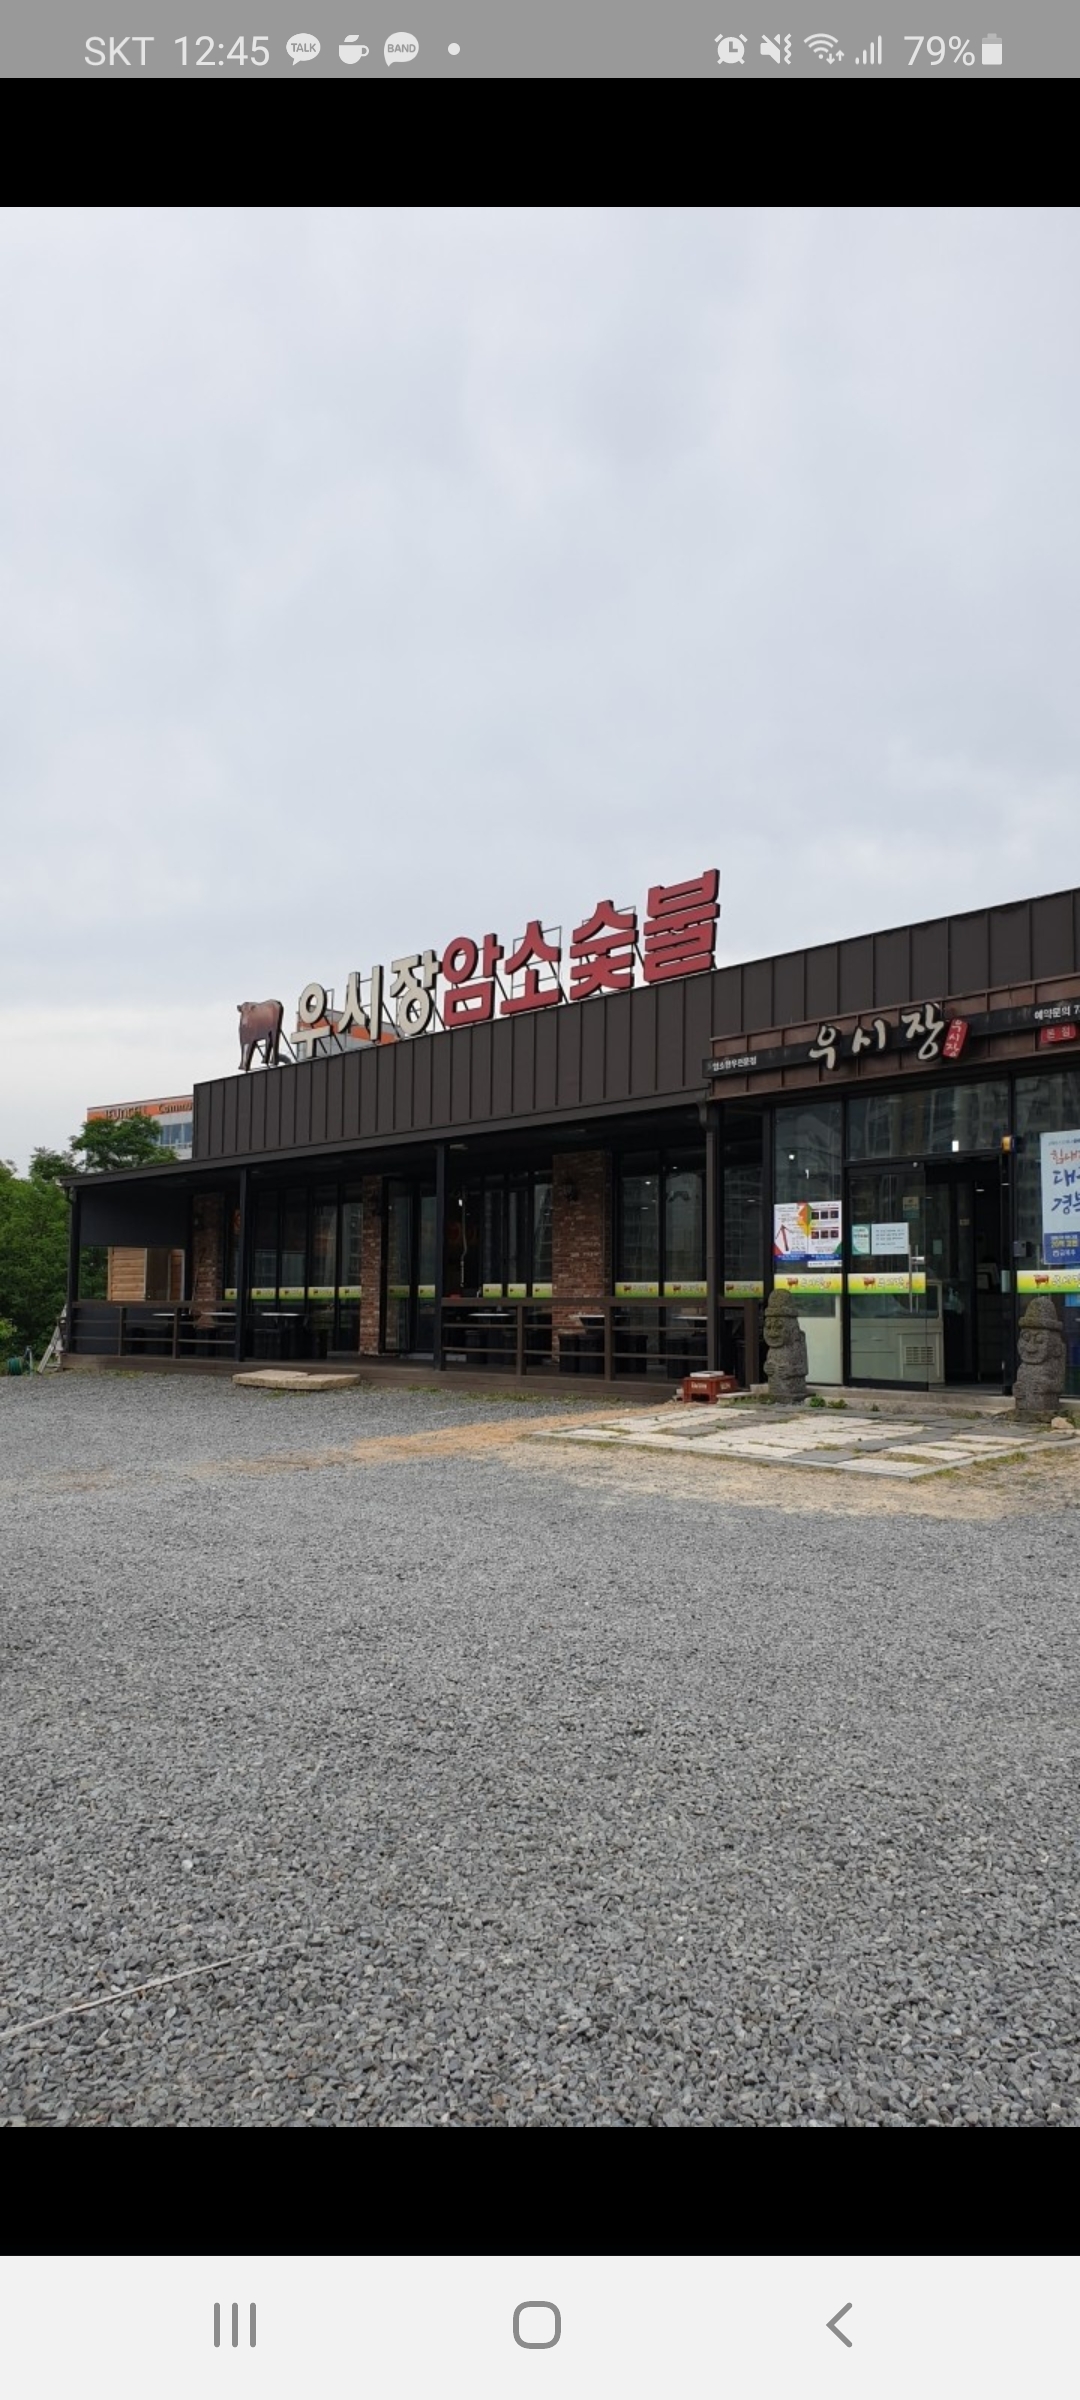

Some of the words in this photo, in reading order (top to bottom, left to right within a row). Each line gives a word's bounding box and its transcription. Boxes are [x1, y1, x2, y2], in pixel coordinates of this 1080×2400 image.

[290, 949, 442, 1058] 우시장
[442, 868, 721, 1027] 암소숯불
[808, 1003, 944, 1070] 우시장
[1034, 1005, 1071, 1020] 예약문의
